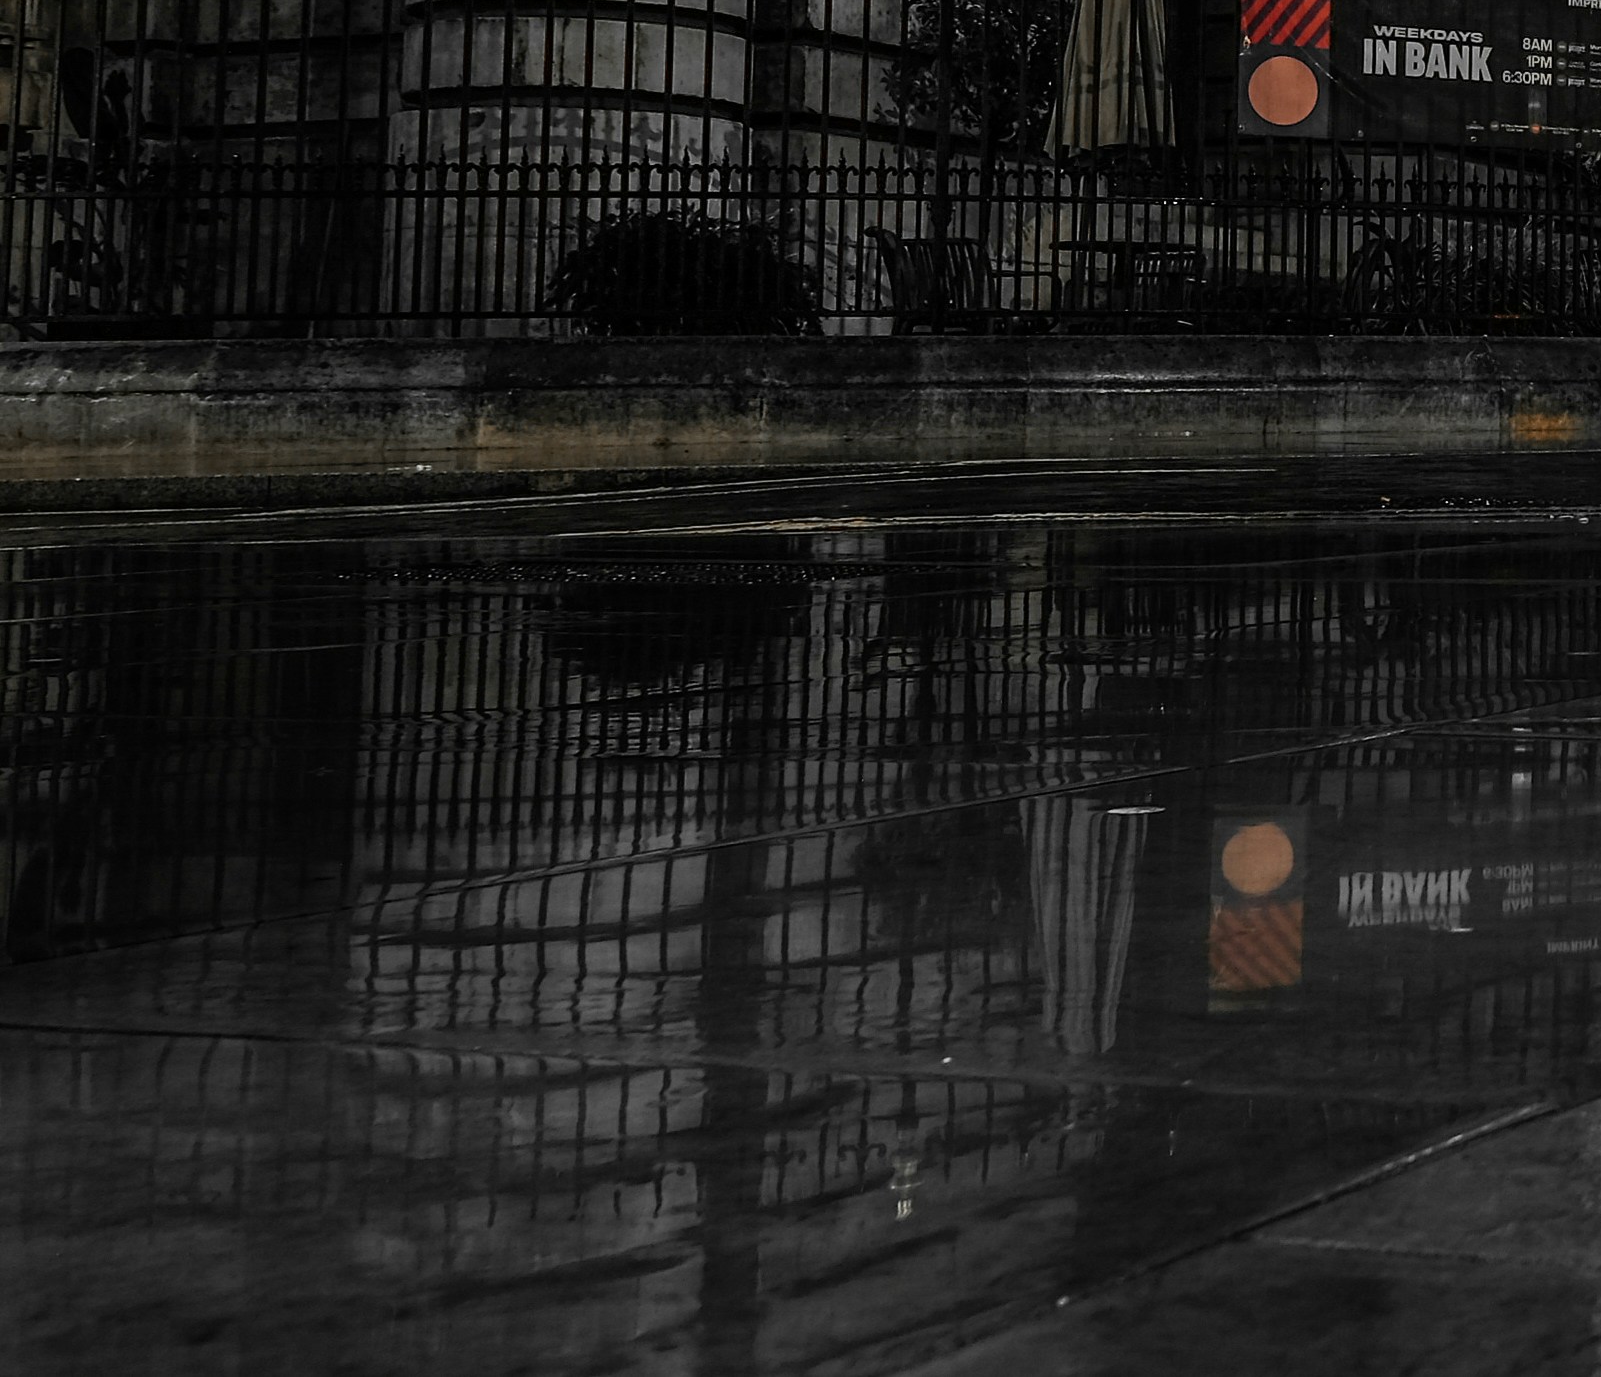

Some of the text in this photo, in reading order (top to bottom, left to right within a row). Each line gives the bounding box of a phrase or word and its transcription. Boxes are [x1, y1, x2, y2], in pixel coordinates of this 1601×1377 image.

[1372, 24, 1484, 44] WEEKDAYS
[1522, 37, 1553, 52] 8AM
[1363, 38, 1494, 83] IN BANK
[1526, 55, 1553, 69] 1PM
[1502, 70, 1553, 86] 6:30PM
